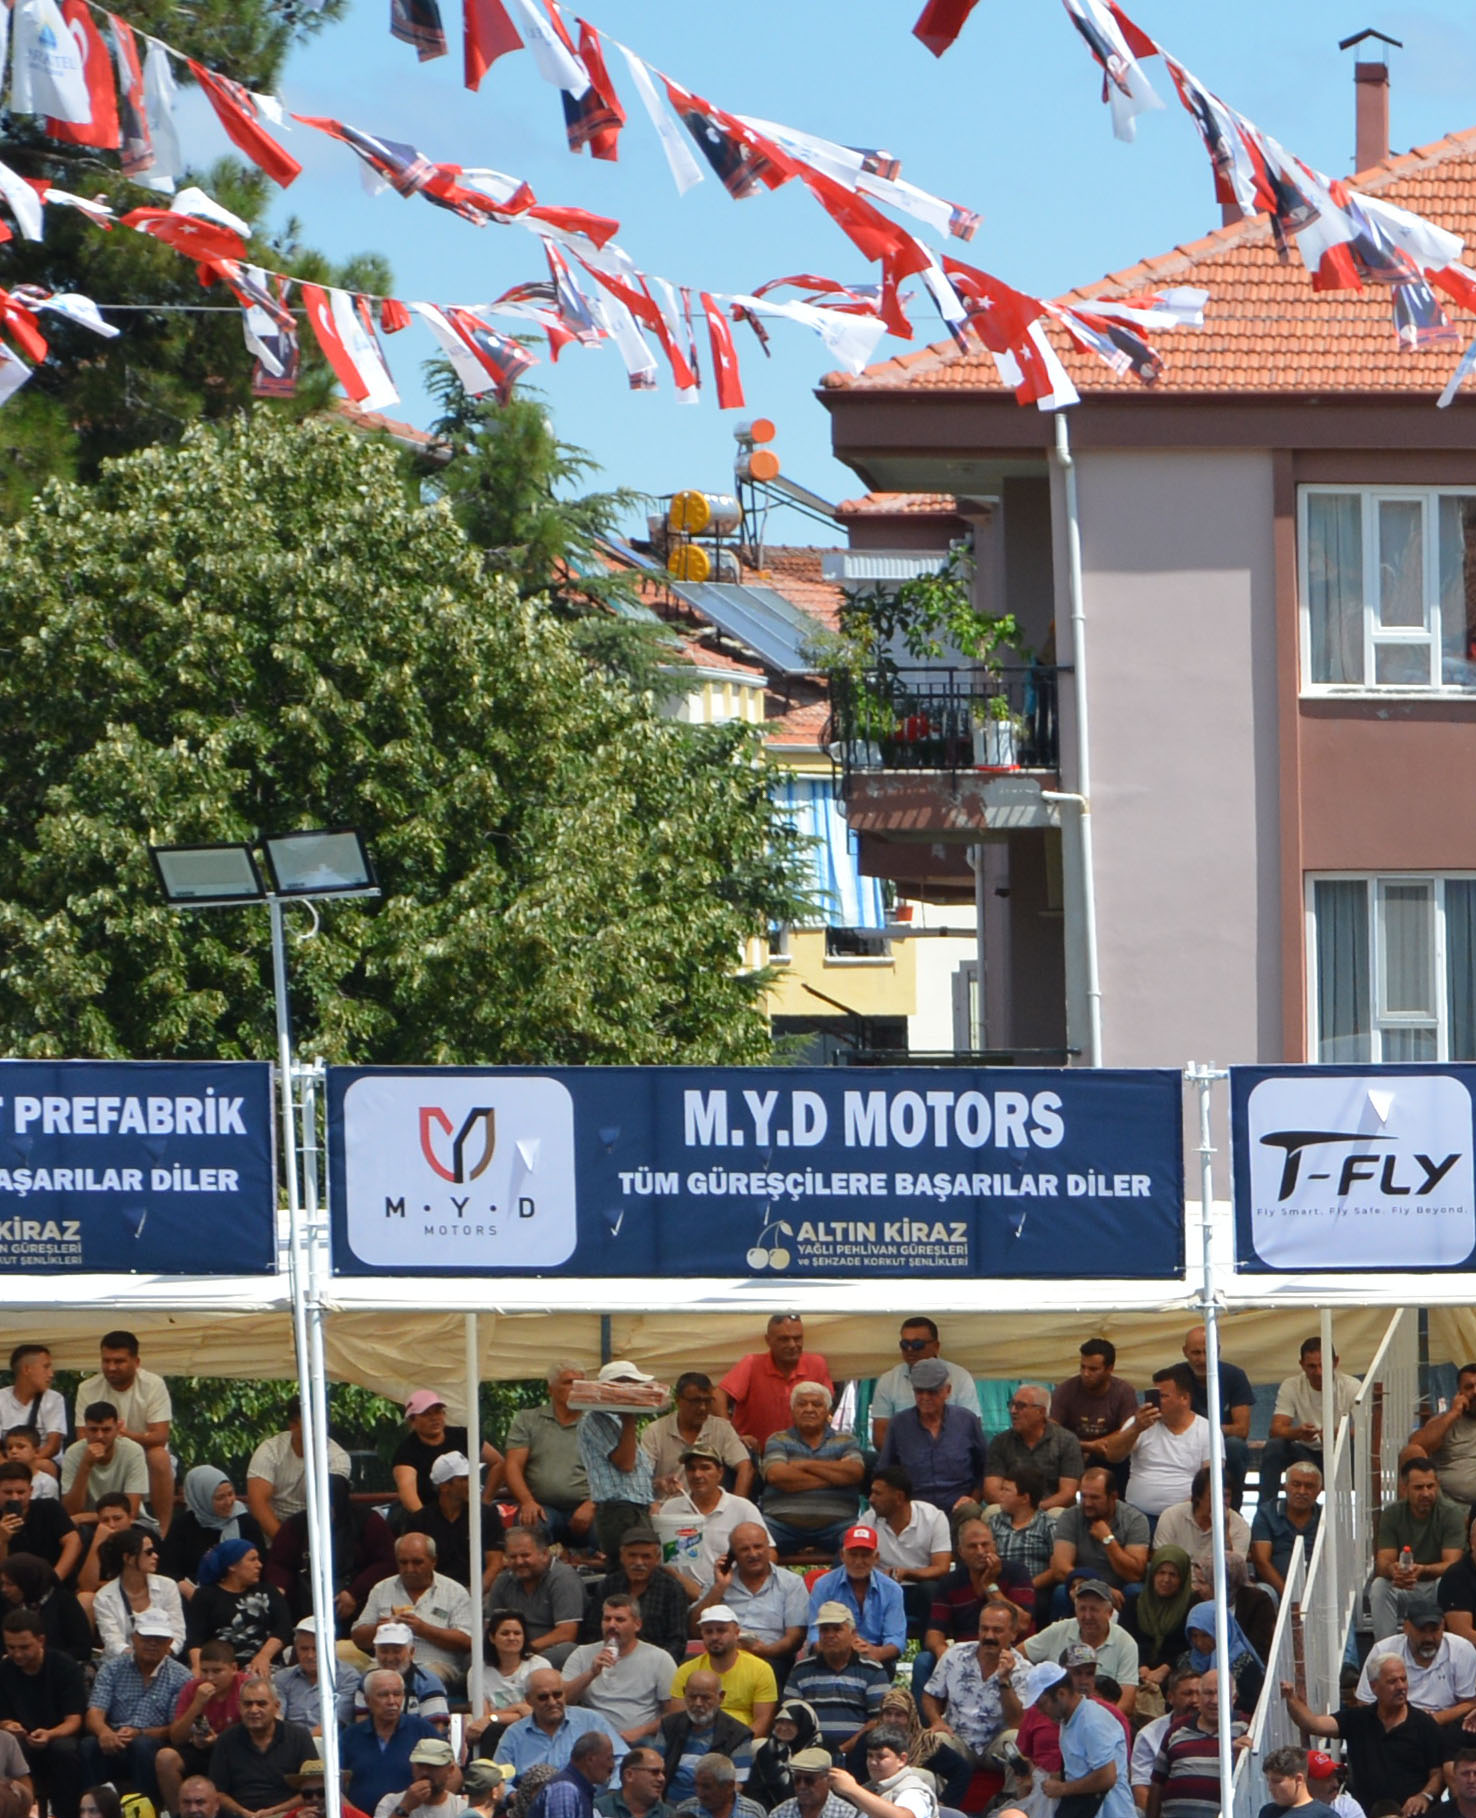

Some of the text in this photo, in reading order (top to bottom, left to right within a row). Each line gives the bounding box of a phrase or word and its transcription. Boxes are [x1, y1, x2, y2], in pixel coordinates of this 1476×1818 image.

[14, 1086, 248, 1135] PREFABRİK
[683, 1089, 1065, 1149] M.Y.D MOTORS
[151, 1162, 240, 1192] DİLER
[1259, 1130, 1463, 1202] T-FLY
[617, 1165, 1151, 1203] TÜM GÜREŞÇİLERE BAŞARILAR DİLER
[424, 1225, 498, 1236] MOTORS
[796, 1217, 968, 1242] ALTIN KİRAZ
[11, 1242, 82, 1256] GÜREŞLERİ
[797, 1242, 968, 1256] YAĞLI PEHLİVAN GÜREŞLERİ
